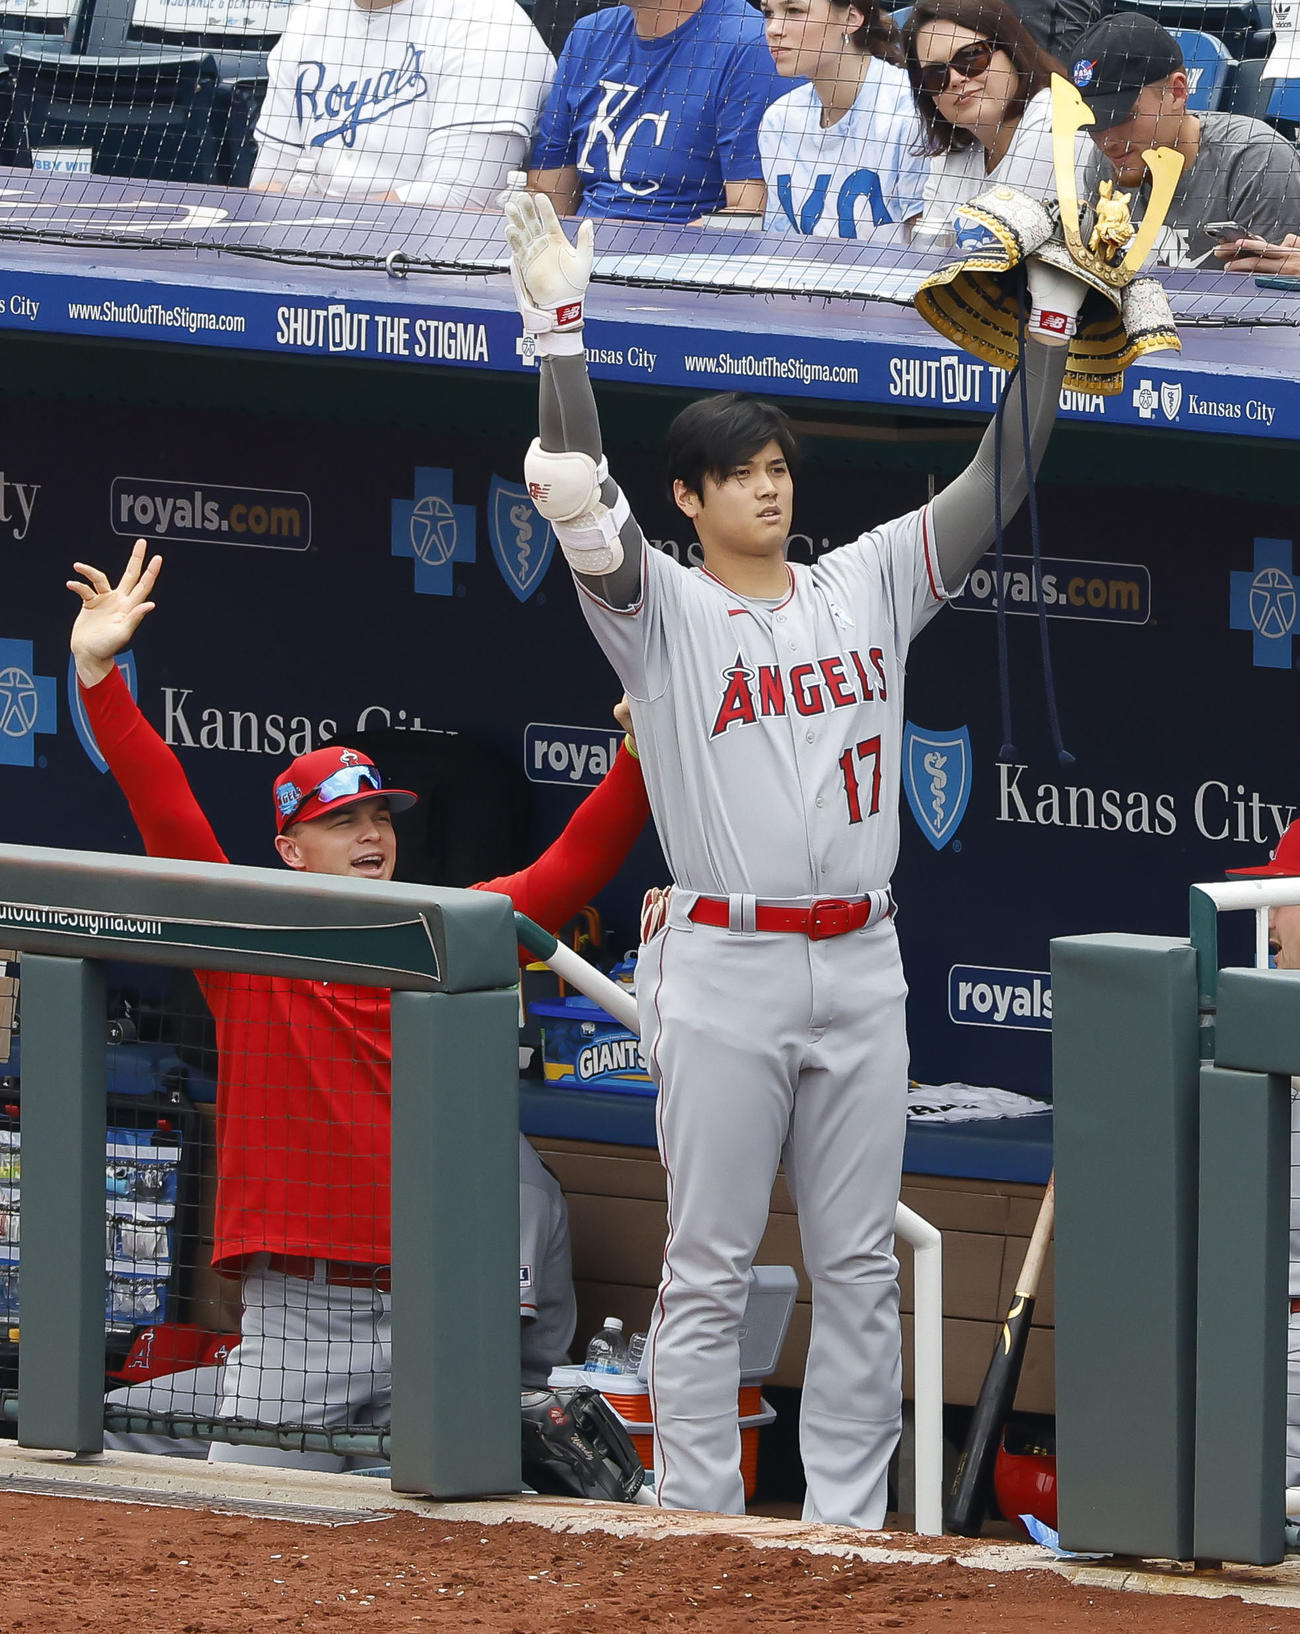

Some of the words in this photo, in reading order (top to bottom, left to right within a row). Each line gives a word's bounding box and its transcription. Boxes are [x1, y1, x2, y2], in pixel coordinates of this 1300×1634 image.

[296, 42, 427, 148] Royals
[577, 79, 670, 196] KC
[9, 295, 40, 320] City
[68, 301, 246, 333] www.ShutOutTheStigma.com
[374, 315, 410, 356] THE
[414, 319, 489, 362] STIGMA
[583, 347, 623, 365] ansas
[627, 346, 657, 373] City
[684, 353, 859, 385] www.ShutOutTheStigma.com
[1188, 394, 1241, 418] Kansas
[1245, 400, 1276, 426] City
[120, 491, 301, 537] royals.com
[962, 564, 1140, 611] oyals.com
[709, 647, 888, 740] ANGELS
[838, 734, 882, 826] 17
[995, 762, 1177, 836] Kansas
[1194, 780, 1297, 861] City
